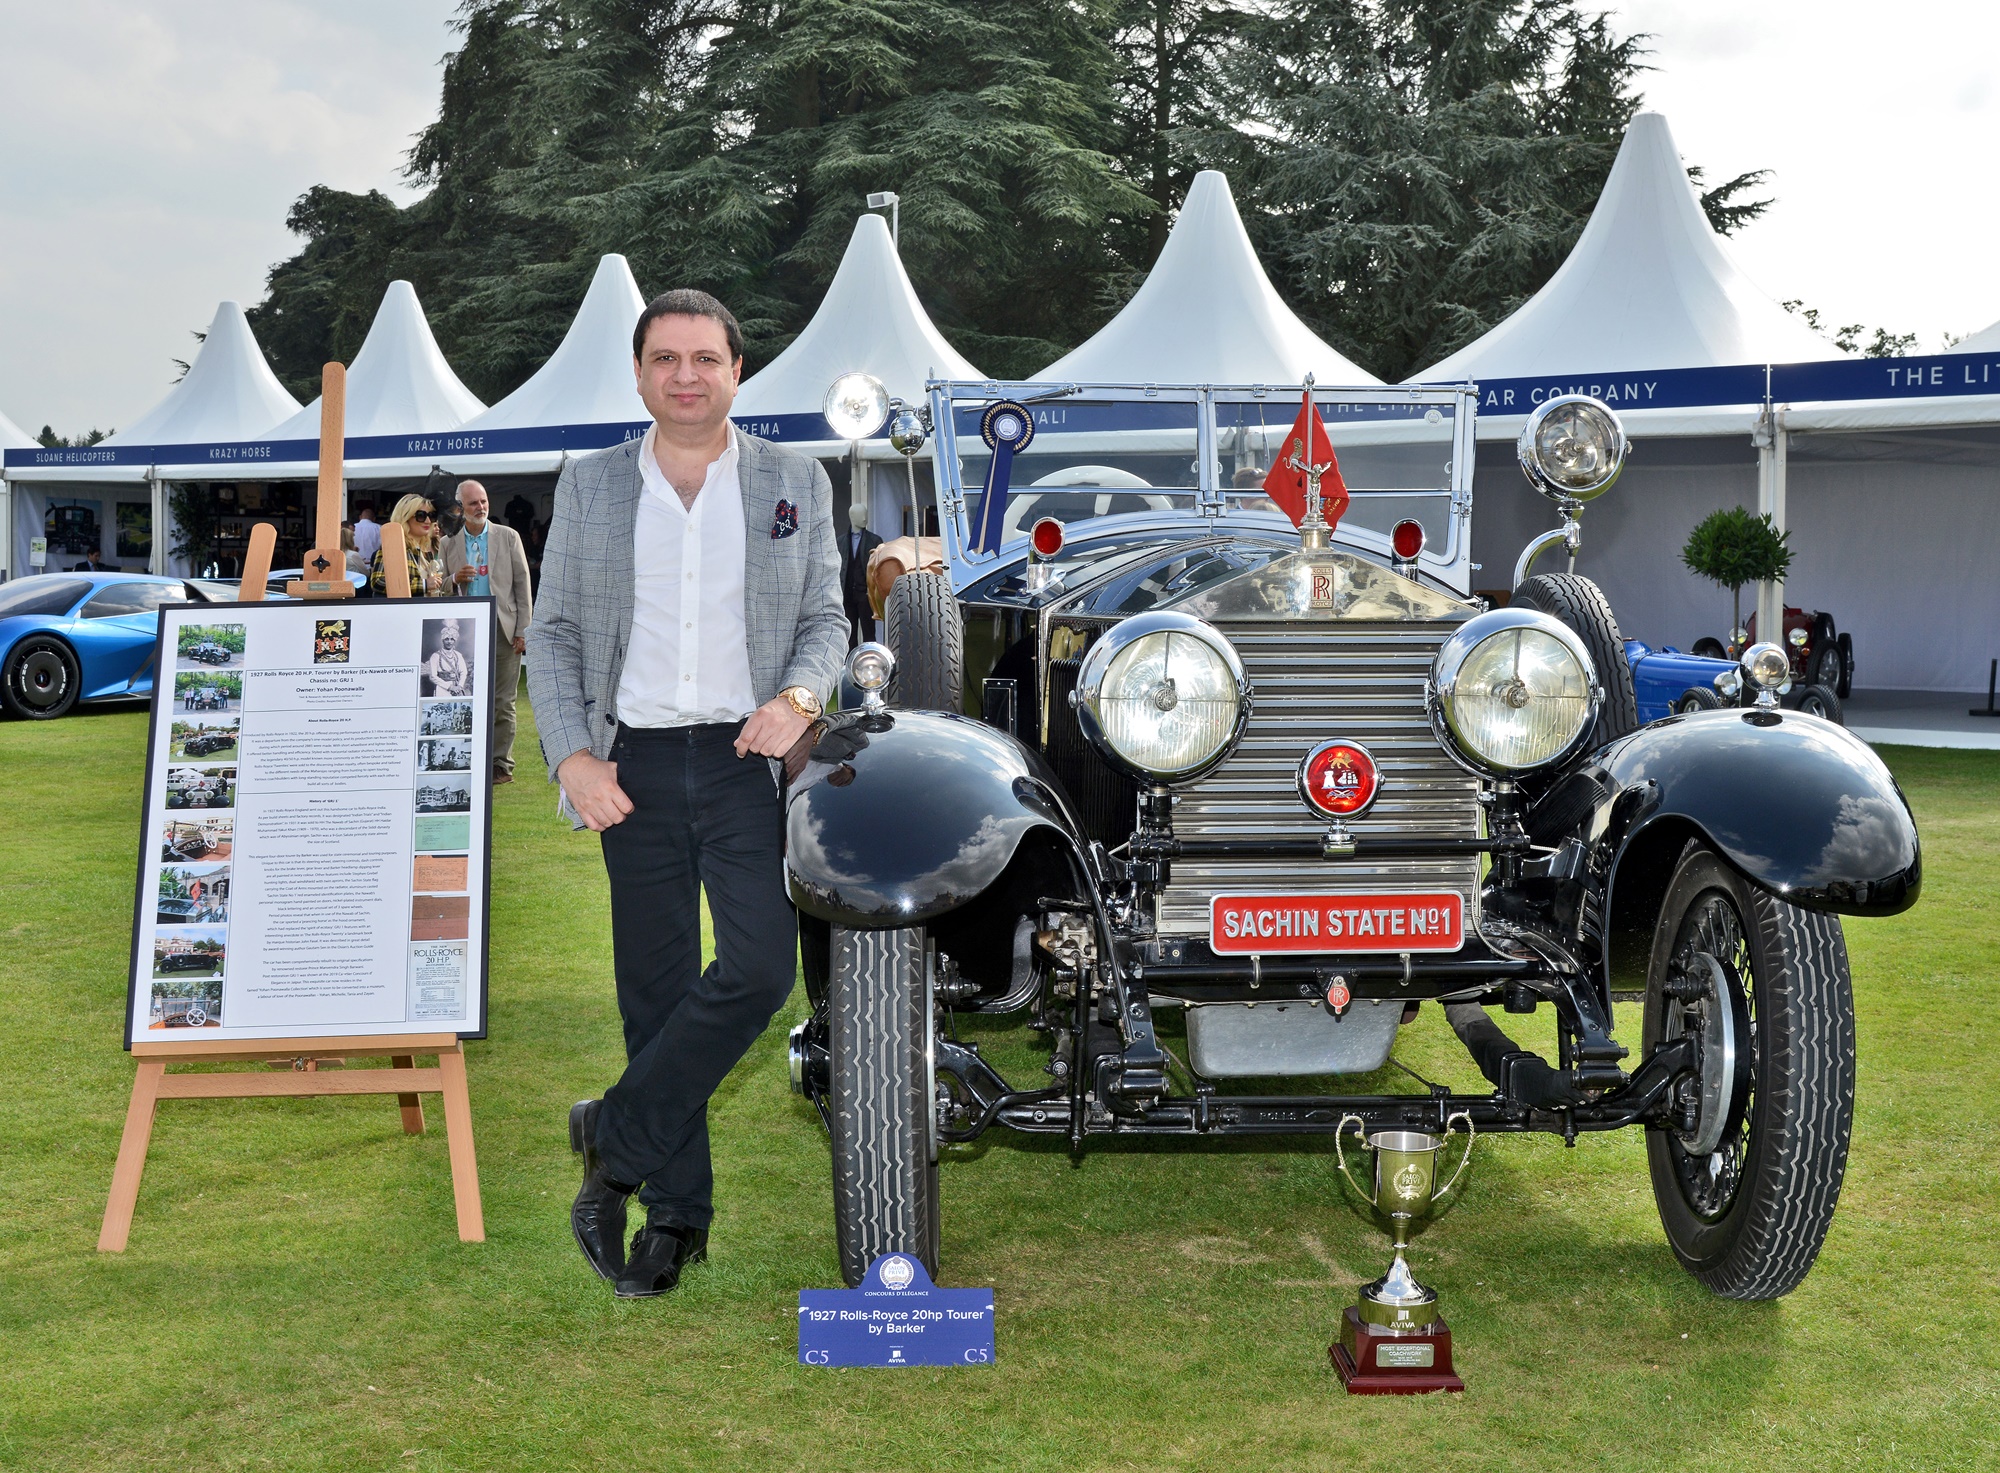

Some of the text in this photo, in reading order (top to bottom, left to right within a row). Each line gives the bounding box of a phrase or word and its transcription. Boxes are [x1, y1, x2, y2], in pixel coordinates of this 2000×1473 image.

[1886, 366, 1943, 386] THE
[1530, 382, 1657, 404] COMPANY
[408, 437, 484, 452] KRAZY HORSE
[36, 451, 116, 463] SLOANE HELICOPTERS
[210, 446, 271, 459] KRAZY HORSE
[1222, 910, 1319, 938] SACHIN
[1326, 909, 1405, 936] STATE
[414, 948, 463, 957] ROLLS-ROYCE
[809, 1310, 984, 1322] 1927 Rolls-Royce 20hp Tourer
[868, 1324, 925, 1336] by Barker
[805, 1350, 829, 1364] C5
[964, 1349, 988, 1363] C5
